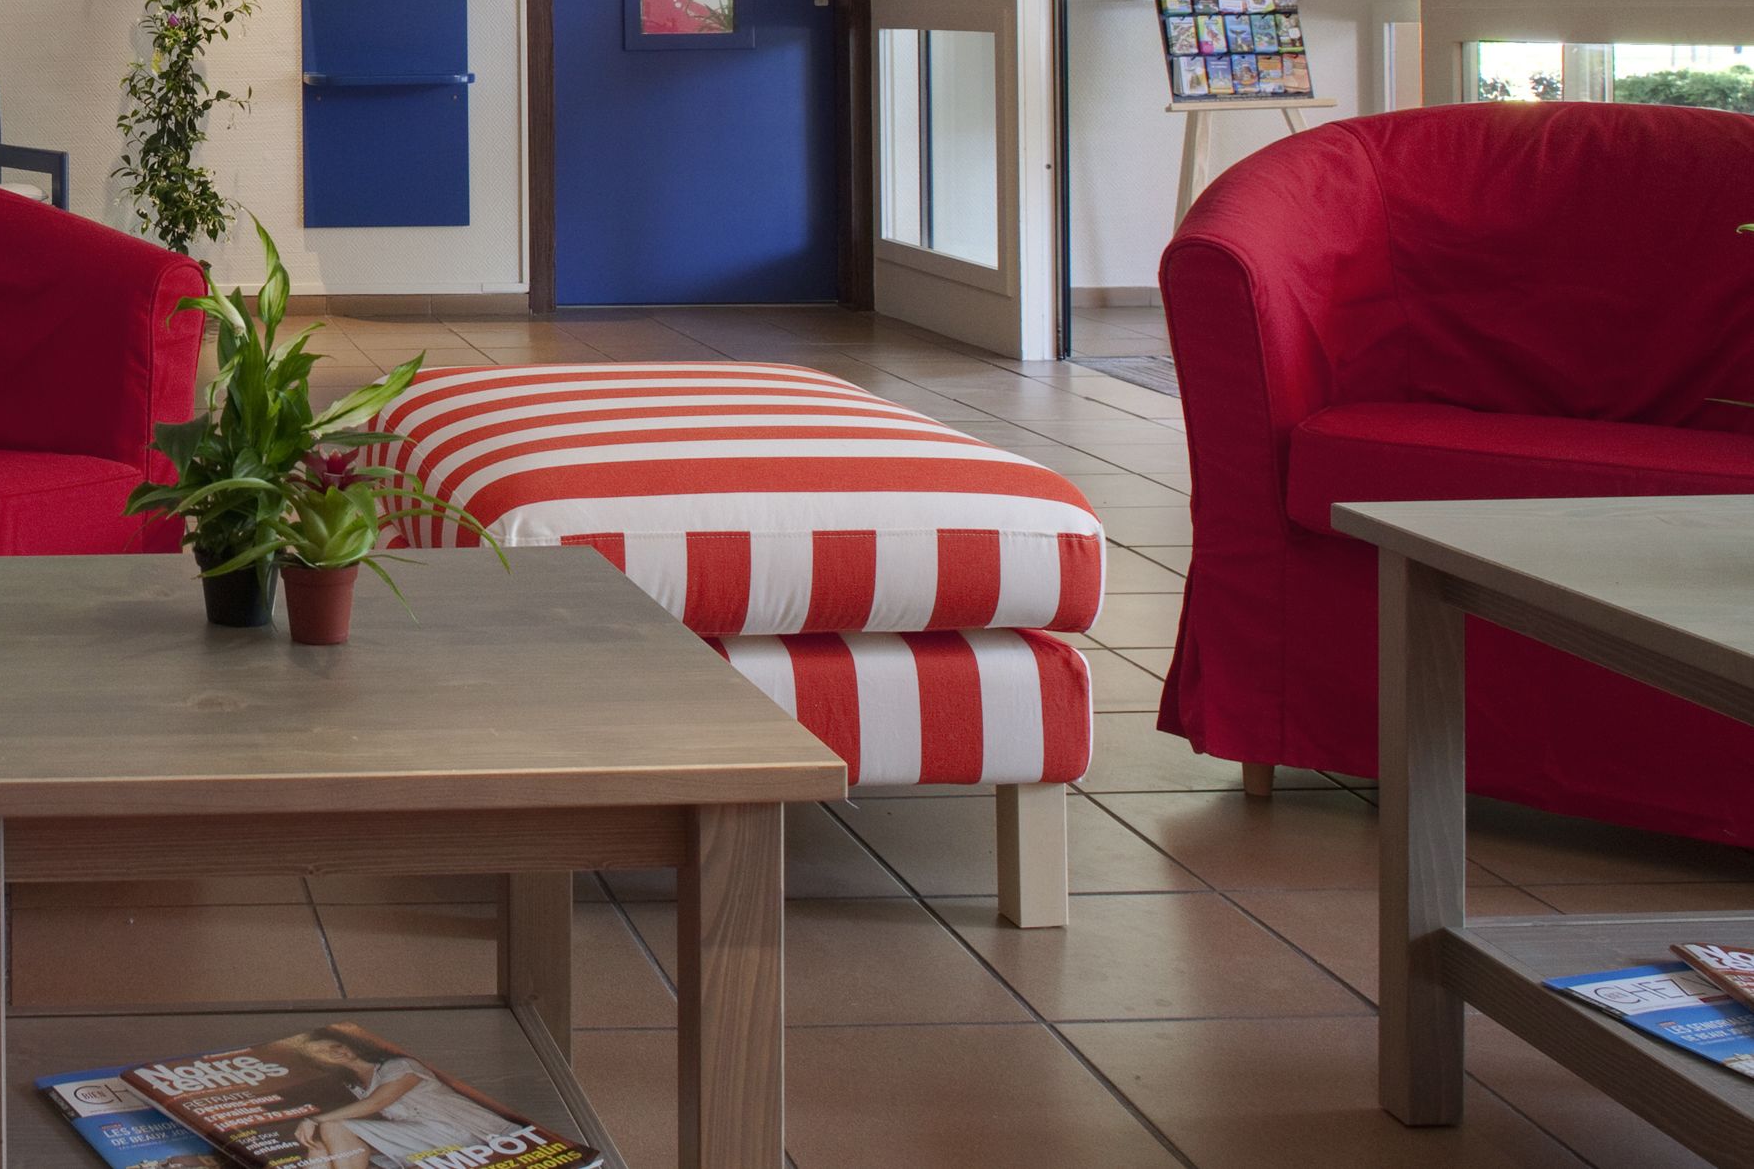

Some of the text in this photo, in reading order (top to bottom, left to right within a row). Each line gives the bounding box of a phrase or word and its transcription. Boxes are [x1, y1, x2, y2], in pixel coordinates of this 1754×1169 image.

[134, 1055, 262, 1083] Notre
[151, 1063, 289, 1097] temps
[81, 1090, 108, 1100] BIEN
[183, 1090, 256, 1111] RETRAITE
[263, 1111, 283, 1120] 70
[103, 1127, 131, 1138] LES
[110, 1138, 129, 1147] DE
[129, 1132, 167, 1144] BEAUX
[517, 1141, 568, 1164] malin
[527, 1149, 582, 1169] moins
